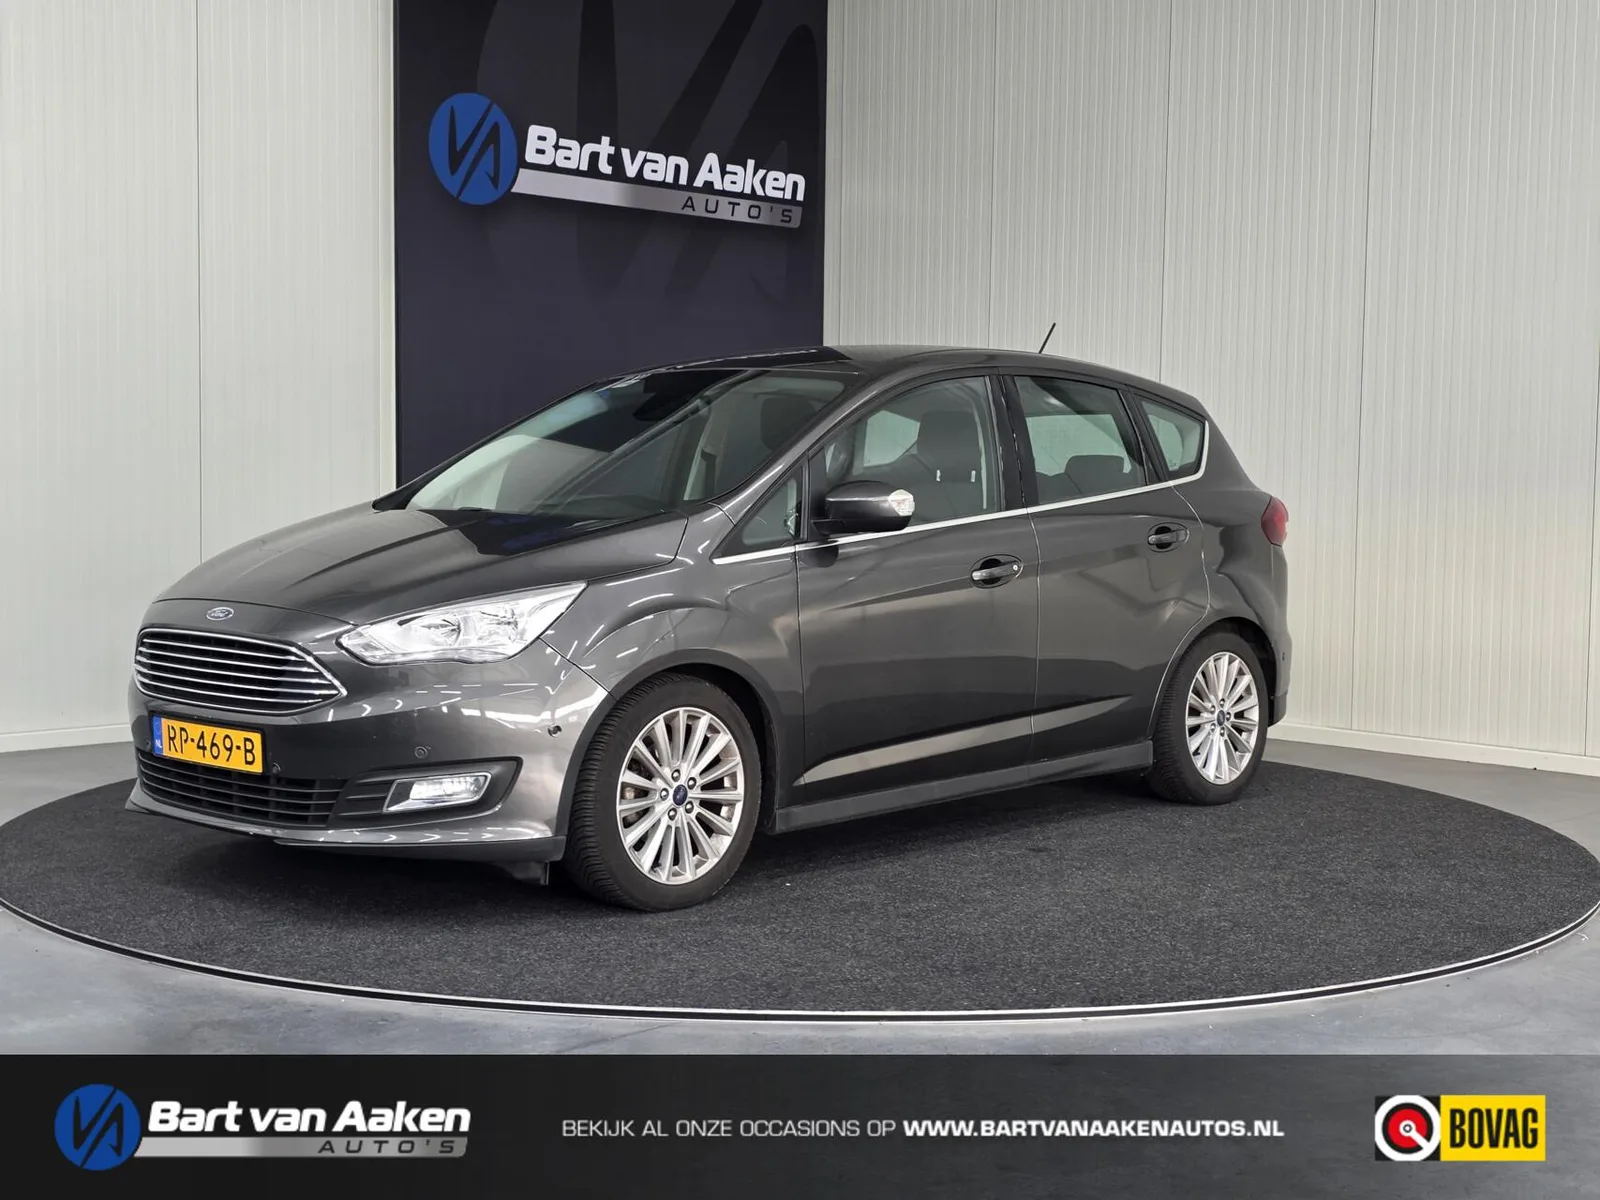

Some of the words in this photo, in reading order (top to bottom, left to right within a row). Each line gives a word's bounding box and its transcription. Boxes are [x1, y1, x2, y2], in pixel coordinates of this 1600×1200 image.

[524, 124, 615, 175] Bart
[620, 146, 689, 186] van
[693, 152, 806, 202] Aaken
[681, 196, 793, 224] AUTO'S
[167, 724, 256, 766] RP-469-B
